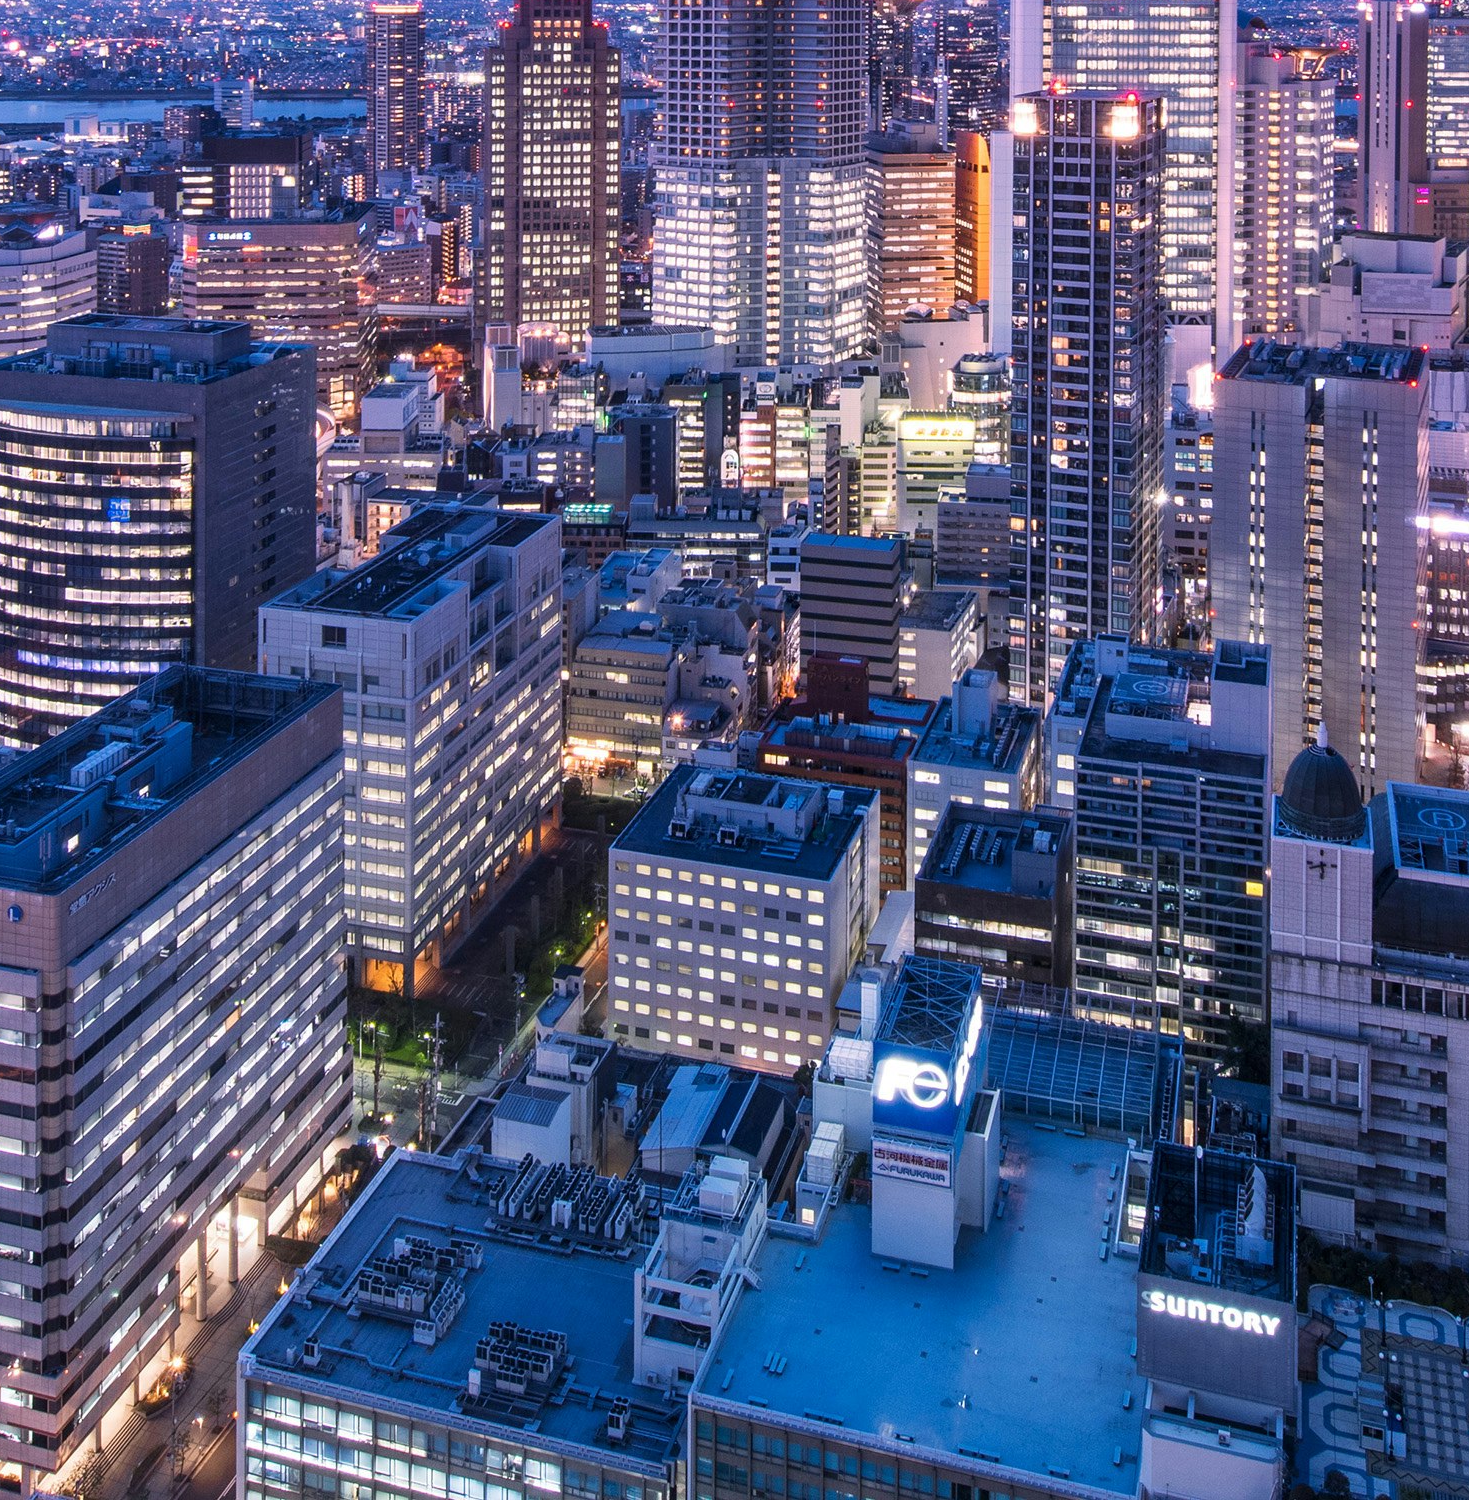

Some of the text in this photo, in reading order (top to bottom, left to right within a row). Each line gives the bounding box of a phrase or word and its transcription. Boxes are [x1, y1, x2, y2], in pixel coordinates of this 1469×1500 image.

[874, 1148, 948, 1171] 古河機械金属
[889, 1165, 946, 1182] FURUKAWA
[1149, 1290, 1281, 1336] SUNTORY
